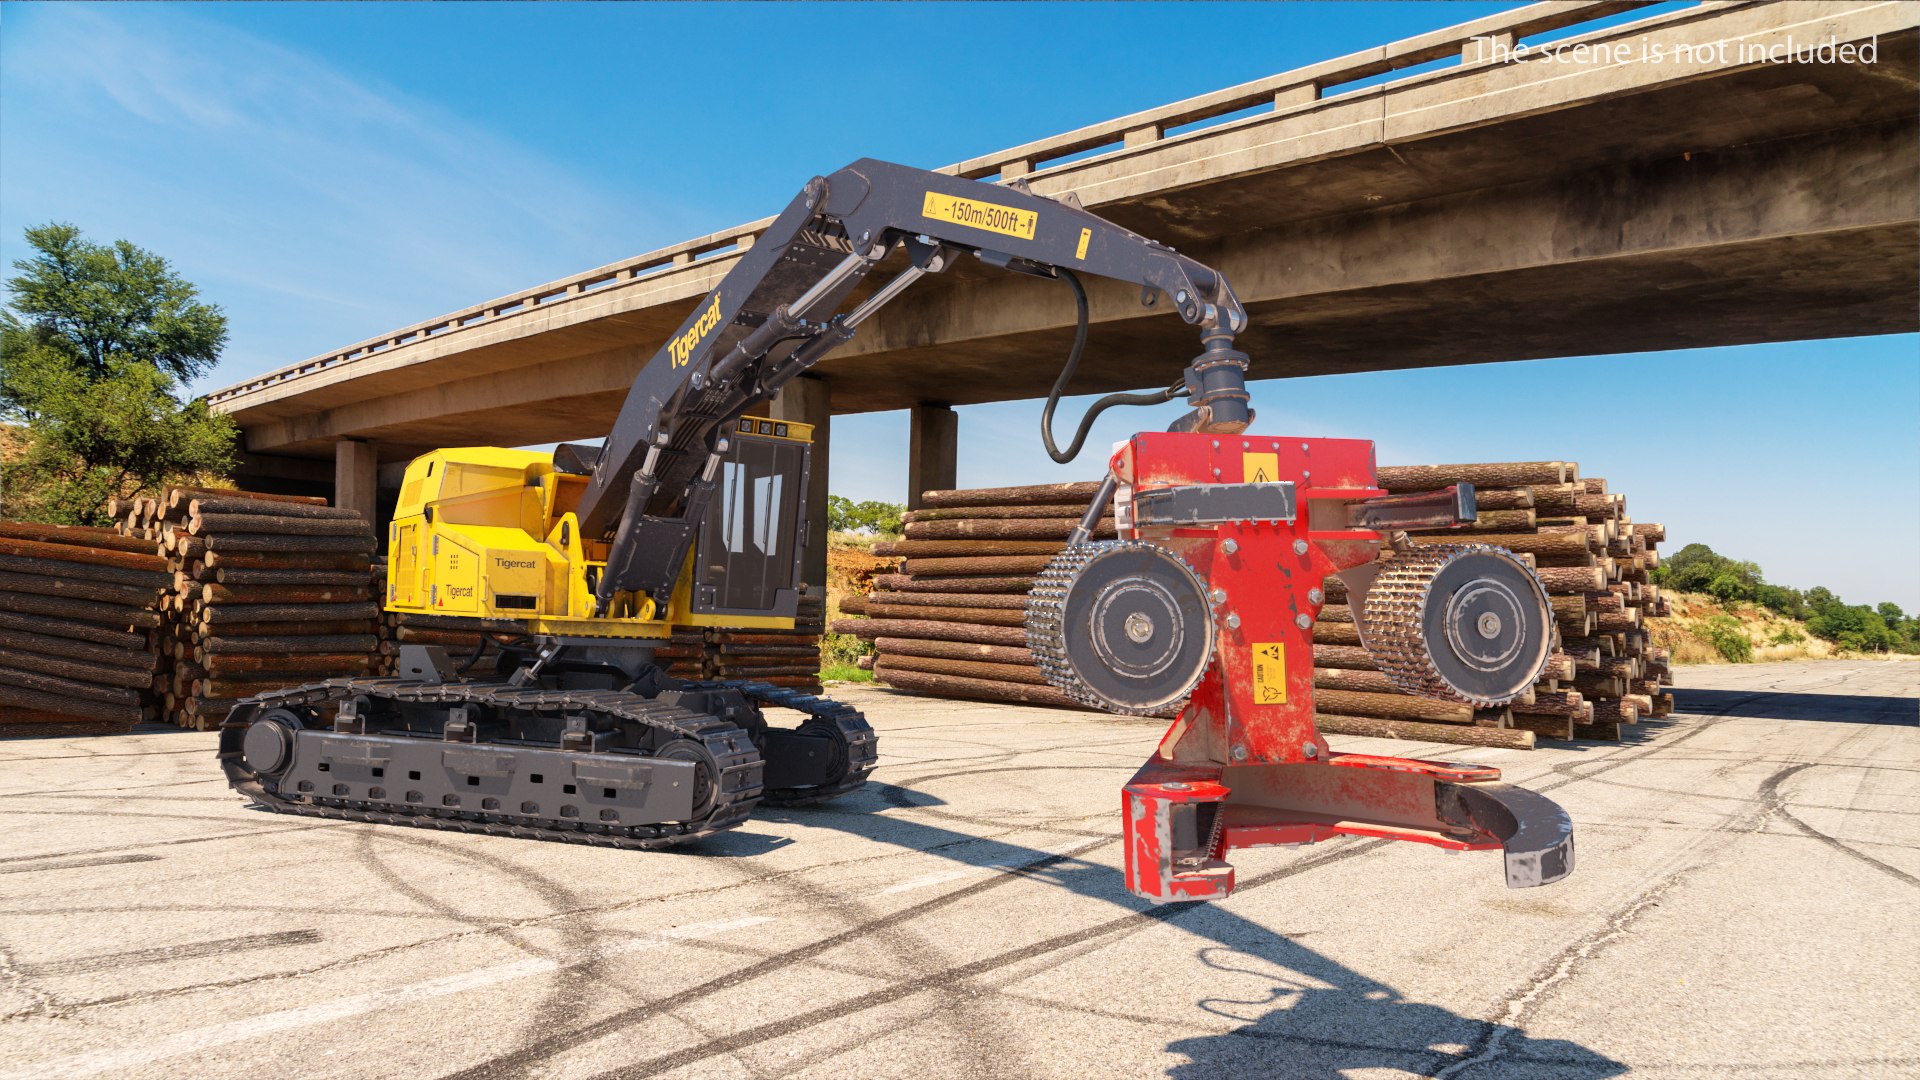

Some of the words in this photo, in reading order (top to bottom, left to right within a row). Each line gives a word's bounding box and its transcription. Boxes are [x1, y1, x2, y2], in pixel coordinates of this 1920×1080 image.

[668, 294, 721, 369] Tigercat
[495, 557, 536, 569] Tigercat
[446, 584, 473, 599] Tigercat
